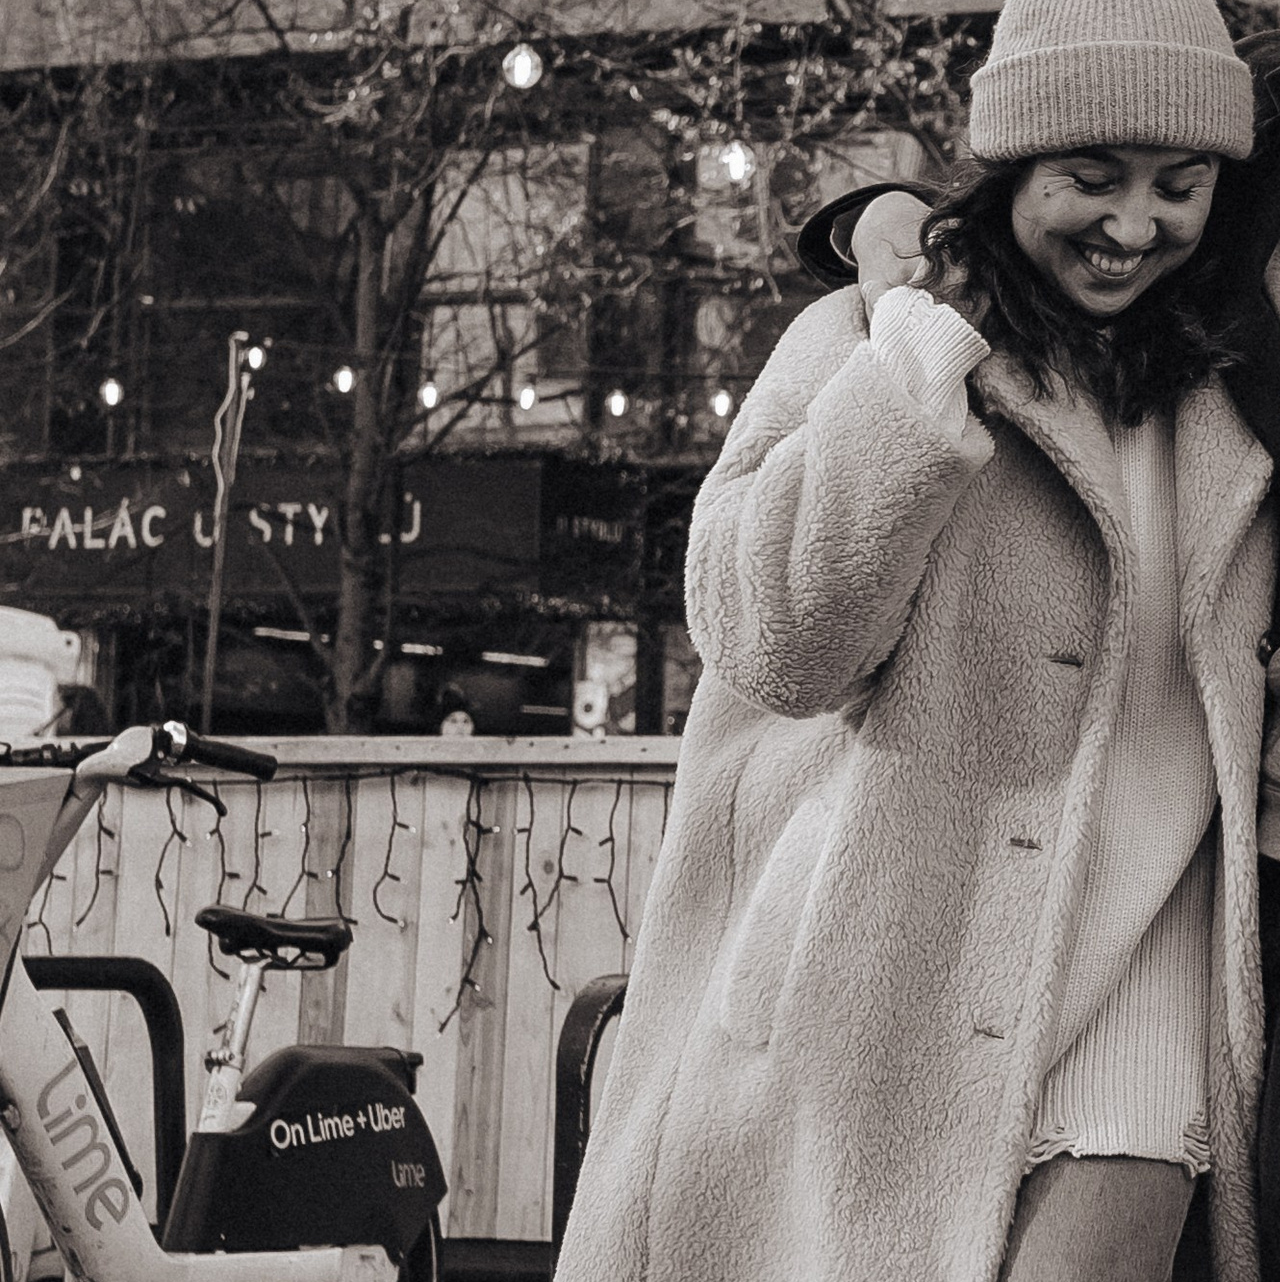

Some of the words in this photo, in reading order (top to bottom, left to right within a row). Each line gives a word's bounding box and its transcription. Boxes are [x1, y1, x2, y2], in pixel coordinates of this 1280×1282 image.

[22, 496, 167, 549] PALÁC
[36, 1057, 130, 1232] Lime
[270, 1118, 306, 1149] On
[306, 1112, 355, 1143] Lime
[367, 1102, 405, 1132] Uber
